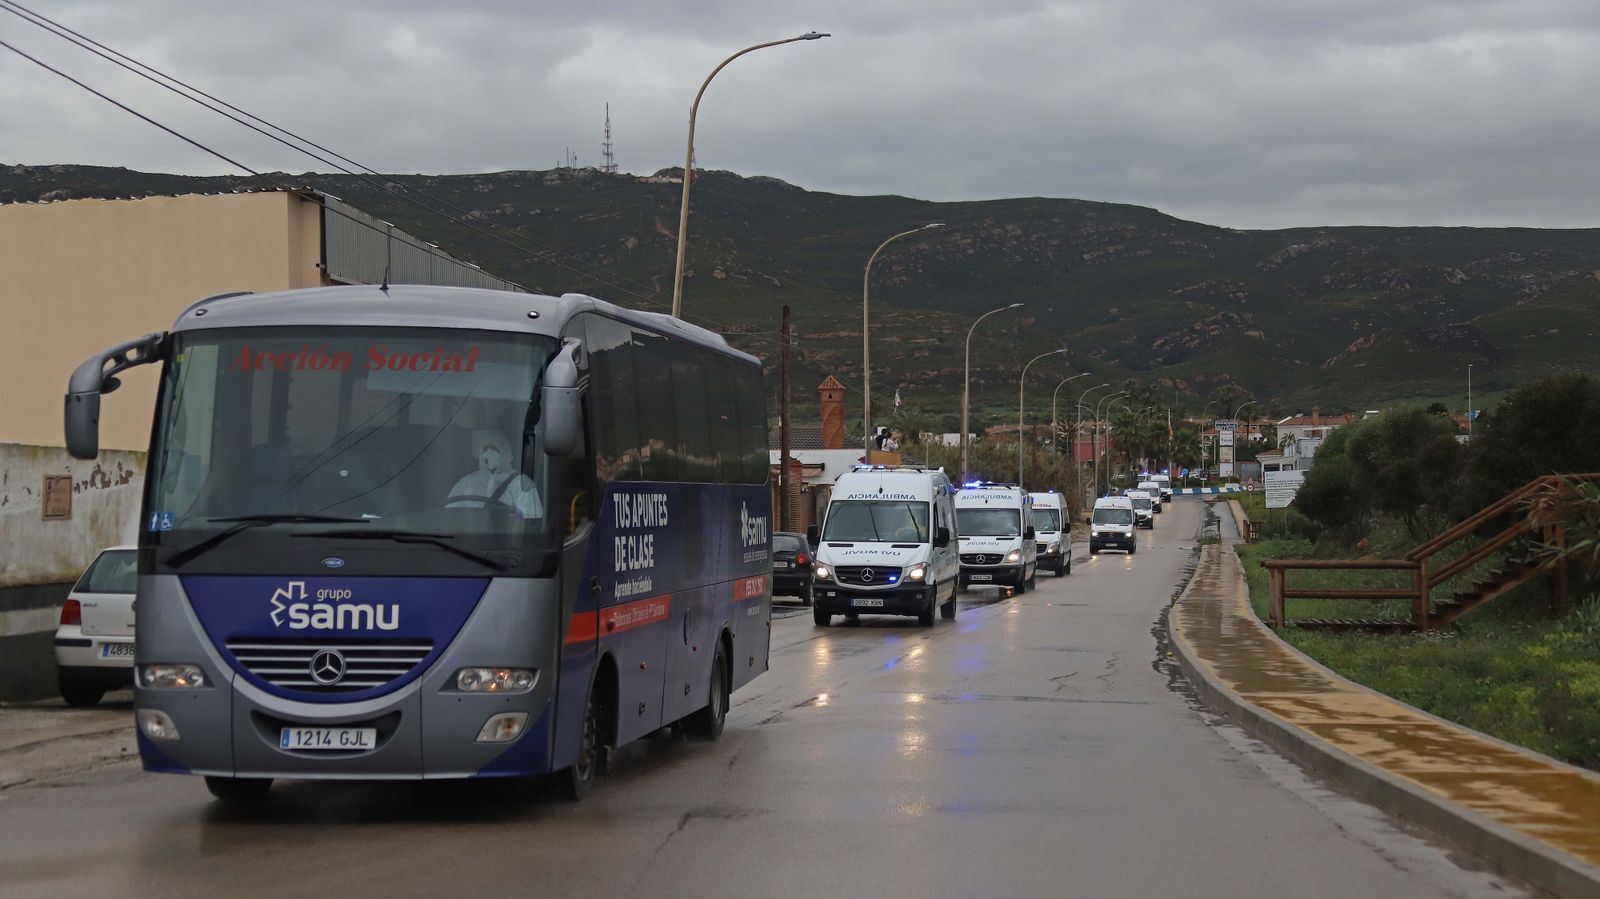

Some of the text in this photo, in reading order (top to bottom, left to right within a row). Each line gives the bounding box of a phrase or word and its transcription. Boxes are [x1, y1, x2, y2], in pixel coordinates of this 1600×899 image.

[229, 343, 480, 372] Acción Social
[613, 493, 667, 528] TUS APUNTES
[748, 516, 767, 546] samu
[615, 534, 654, 572] DE CLASE
[317, 589, 352, 601] grupo
[288, 603, 399, 630] samu
[296, 730, 368, 746] 1214 GJL
